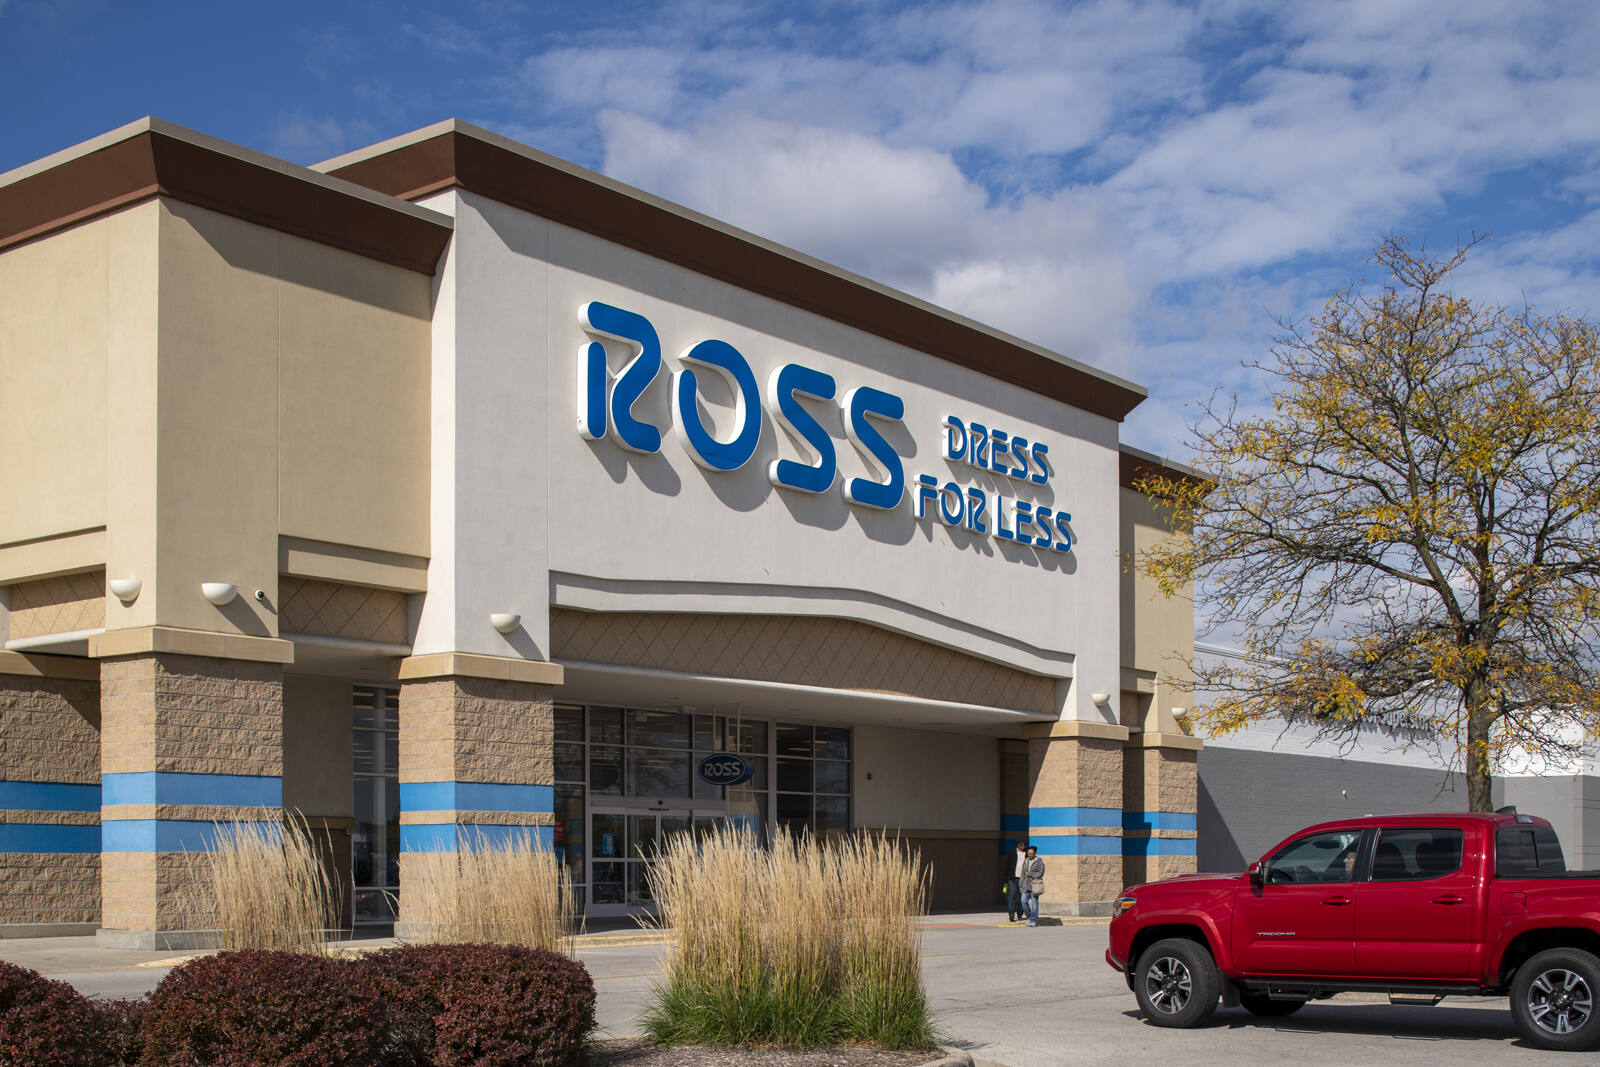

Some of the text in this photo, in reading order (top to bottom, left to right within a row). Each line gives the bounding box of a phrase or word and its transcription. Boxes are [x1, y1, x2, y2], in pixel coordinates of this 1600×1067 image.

[577, 301, 904, 510] ROSS
[942, 415, 1048, 485] DRESS
[914, 473, 1072, 553] FOR LESS
[704, 761, 741, 777] ROSS
